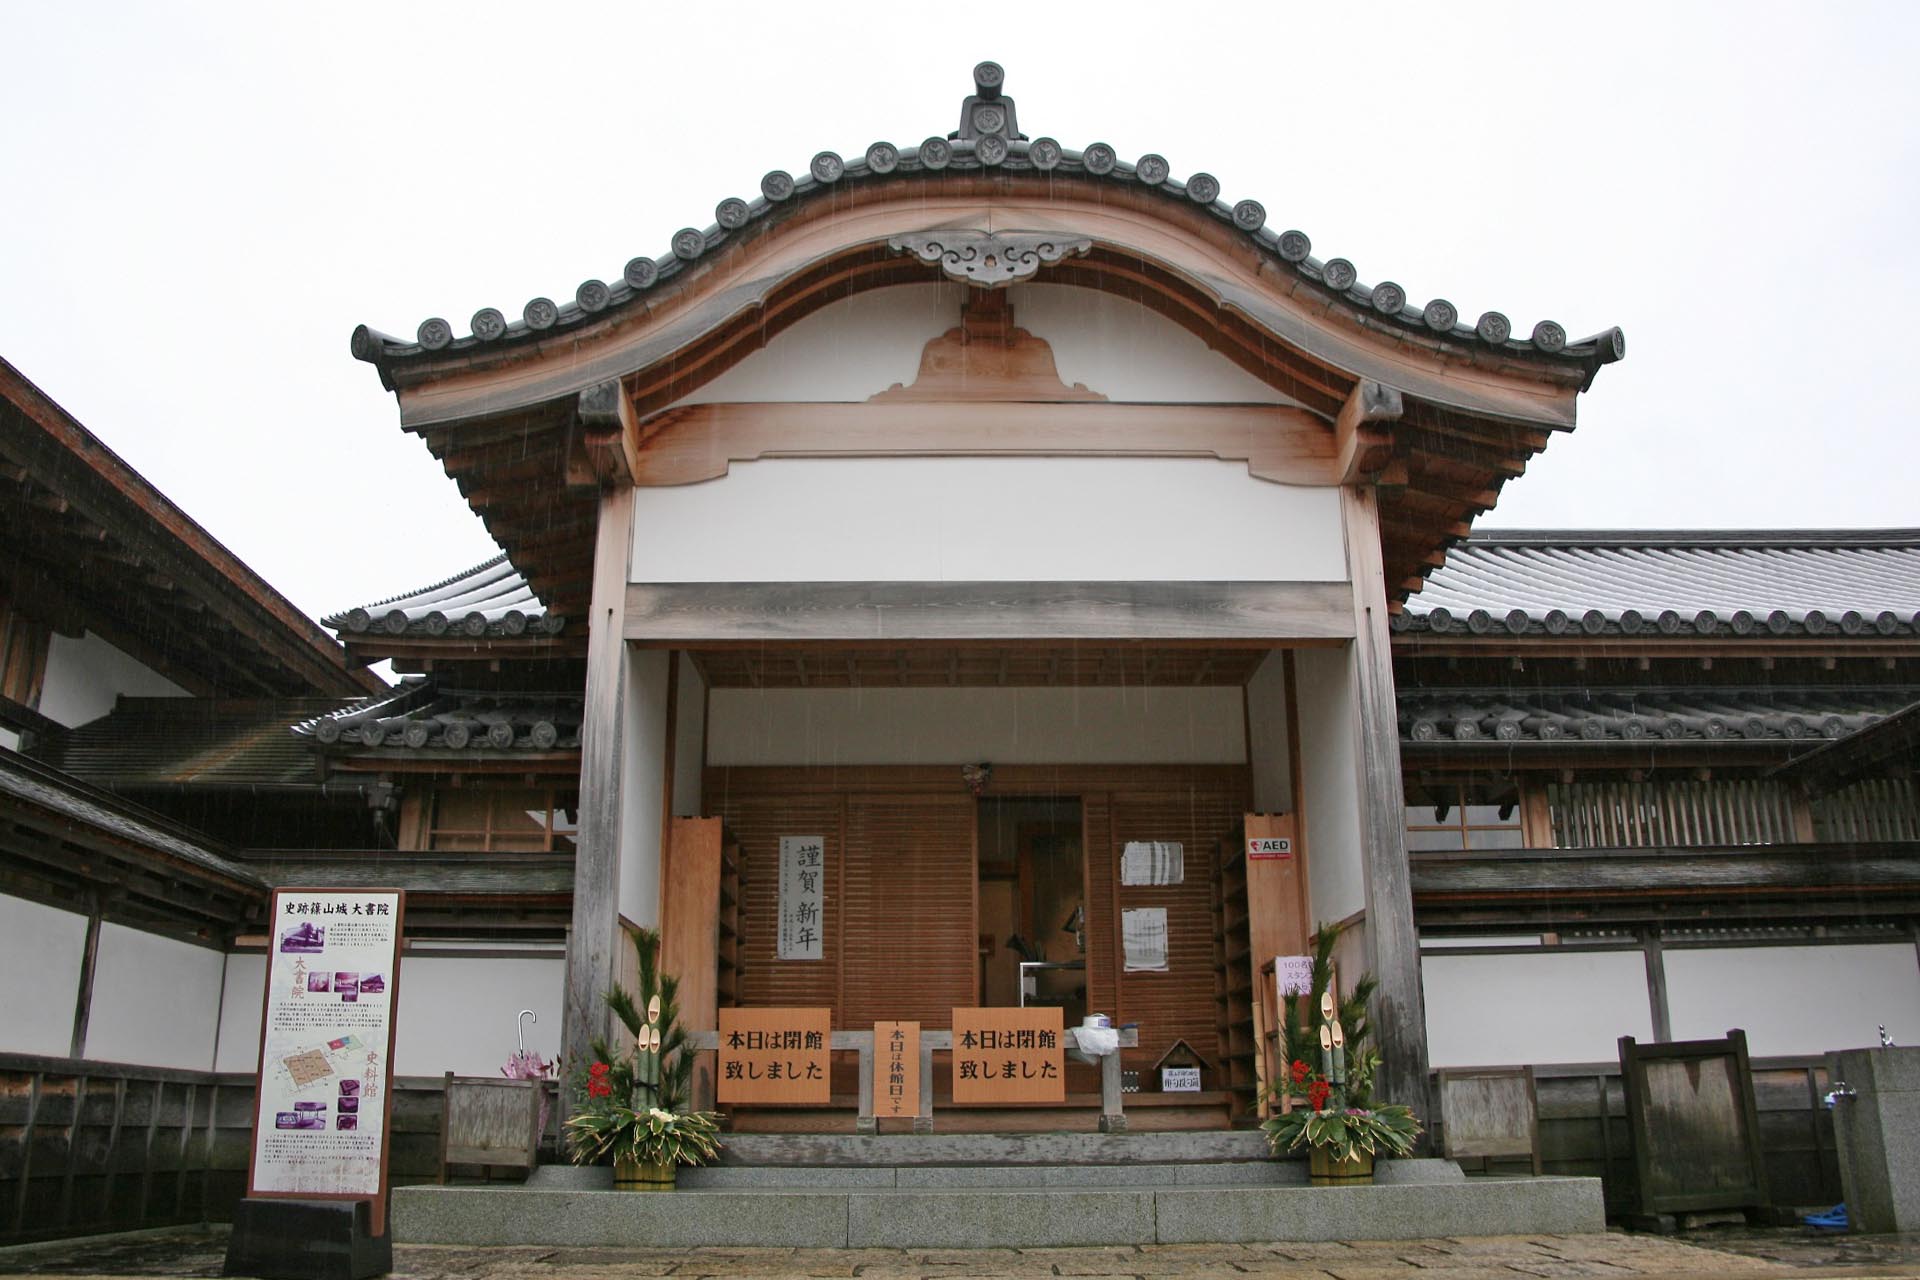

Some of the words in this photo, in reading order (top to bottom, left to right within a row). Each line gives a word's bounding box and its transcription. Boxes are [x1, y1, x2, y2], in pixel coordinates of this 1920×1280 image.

[1263, 841, 1288, 850] AED
[796, 845, 821, 952] 謹賀新年
[292, 957, 306, 999] 大書院
[727, 1030, 823, 1050] 本日は閉館
[960, 1029, 1056, 1049] 本日は閉館
[364, 1051, 378, 1098] 史料館
[726, 1061, 823, 1080] 致しました
[889, 1030, 904, 1113] 本日は休館日です
[960, 1060, 1057, 1079] 致しました
